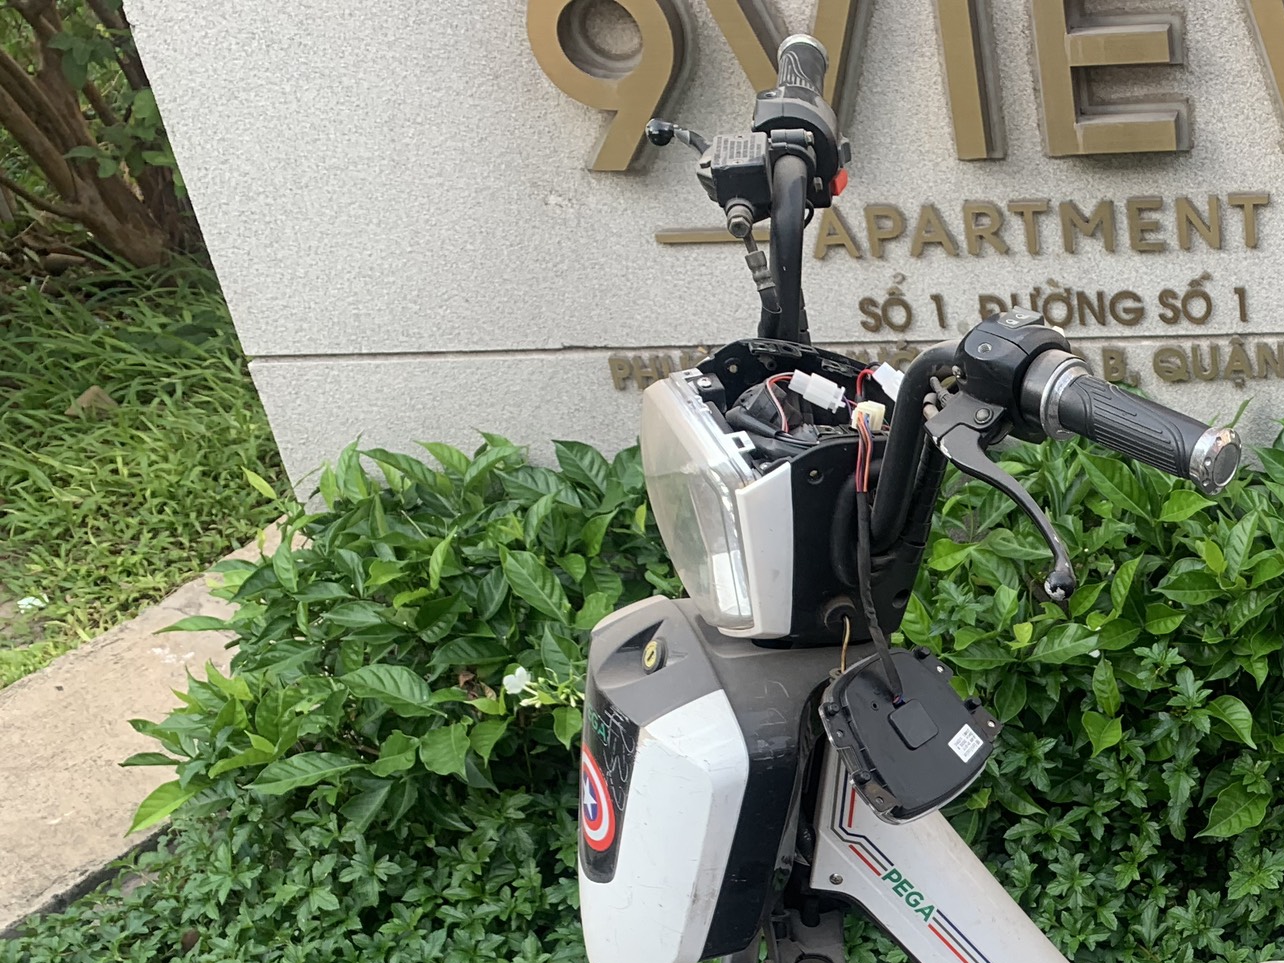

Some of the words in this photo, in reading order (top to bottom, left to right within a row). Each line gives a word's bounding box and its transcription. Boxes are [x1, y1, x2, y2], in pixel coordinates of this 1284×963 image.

[813, 192, 1271, 260] APARTMENT
[1233, 286, 1249, 324] 1
[881, 867, 936, 923] PEGA
